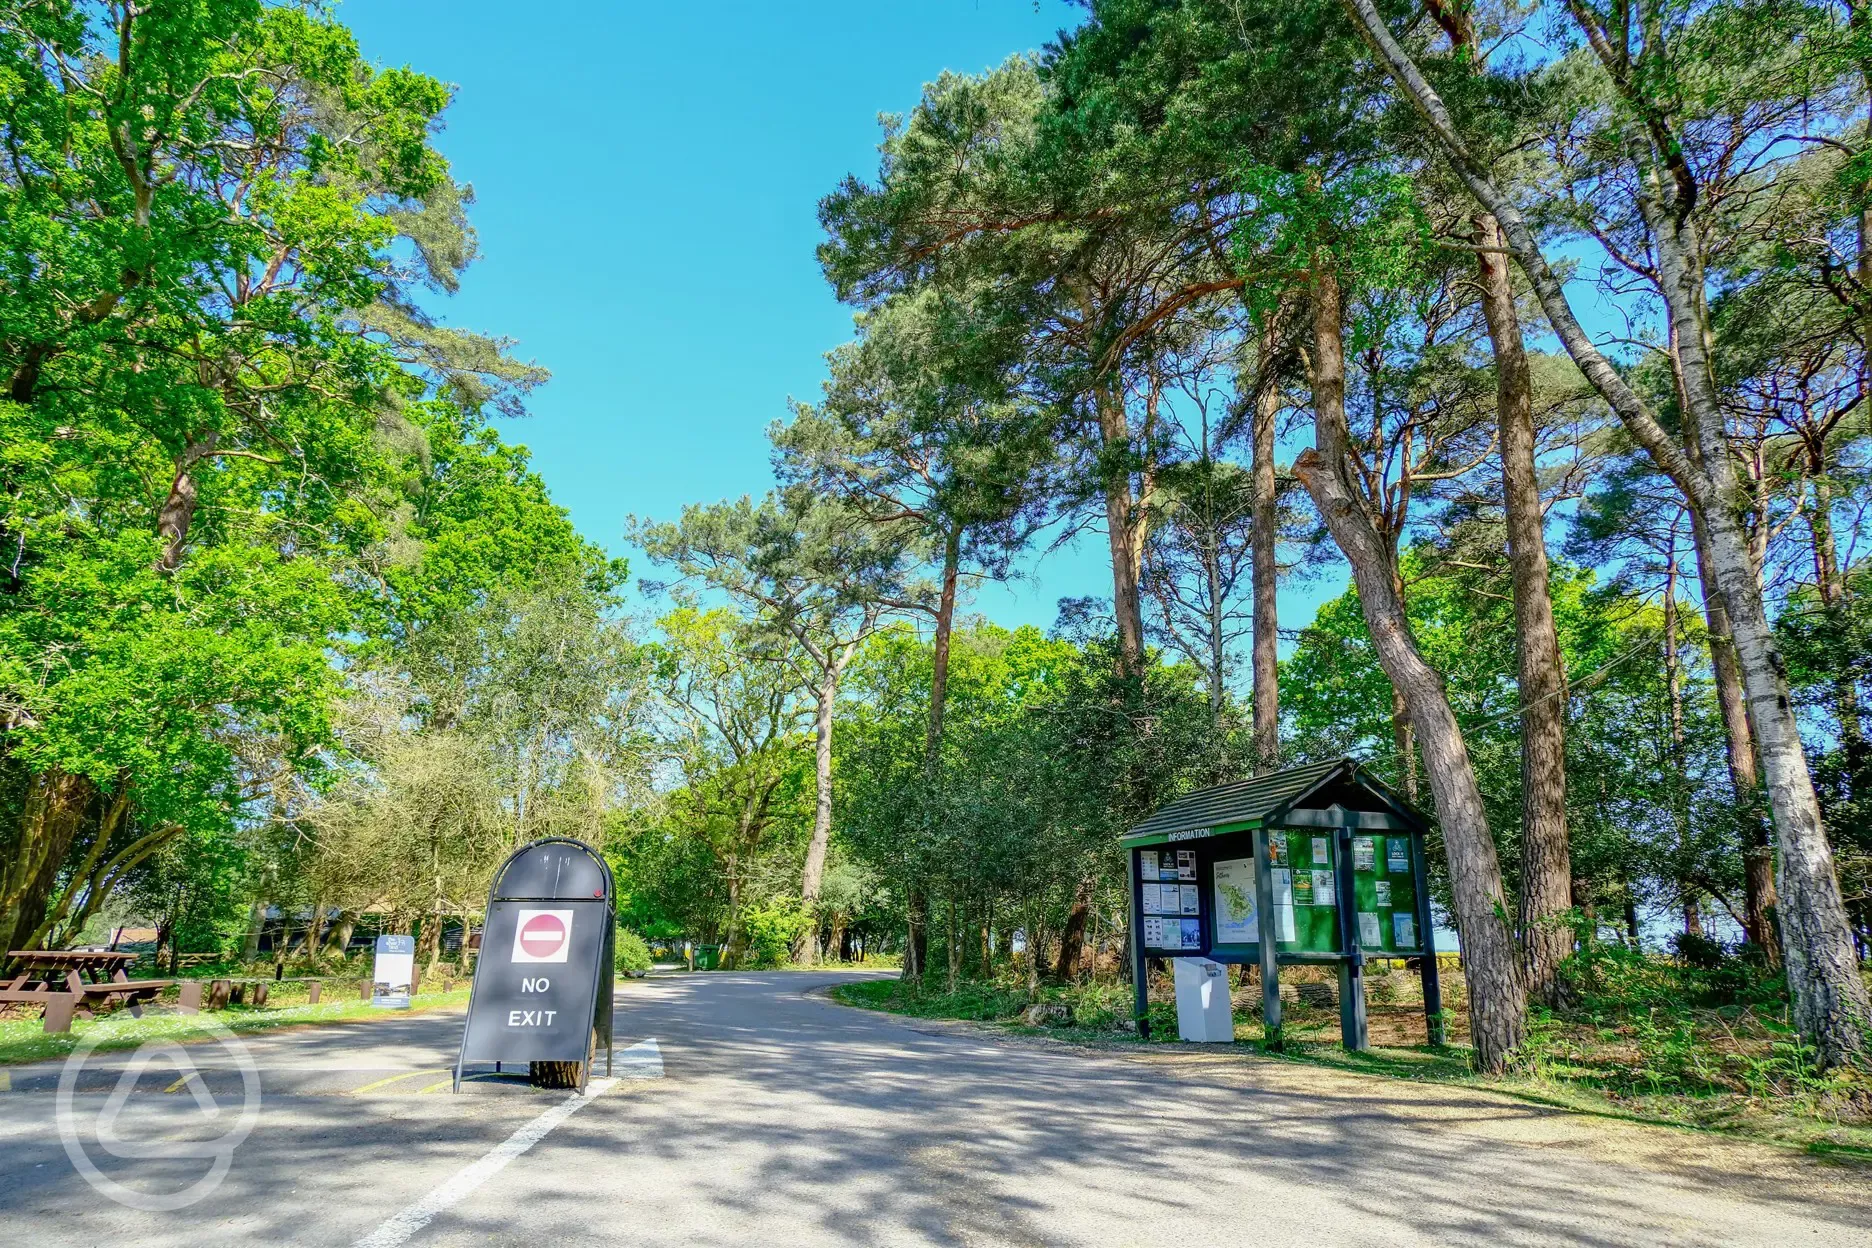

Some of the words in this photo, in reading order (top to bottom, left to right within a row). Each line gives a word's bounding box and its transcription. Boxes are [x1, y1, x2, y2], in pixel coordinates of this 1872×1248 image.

[1168, 828, 1210, 842] INFORMATION
[521, 978, 550, 993] NO
[508, 1011, 557, 1026] EXIT
